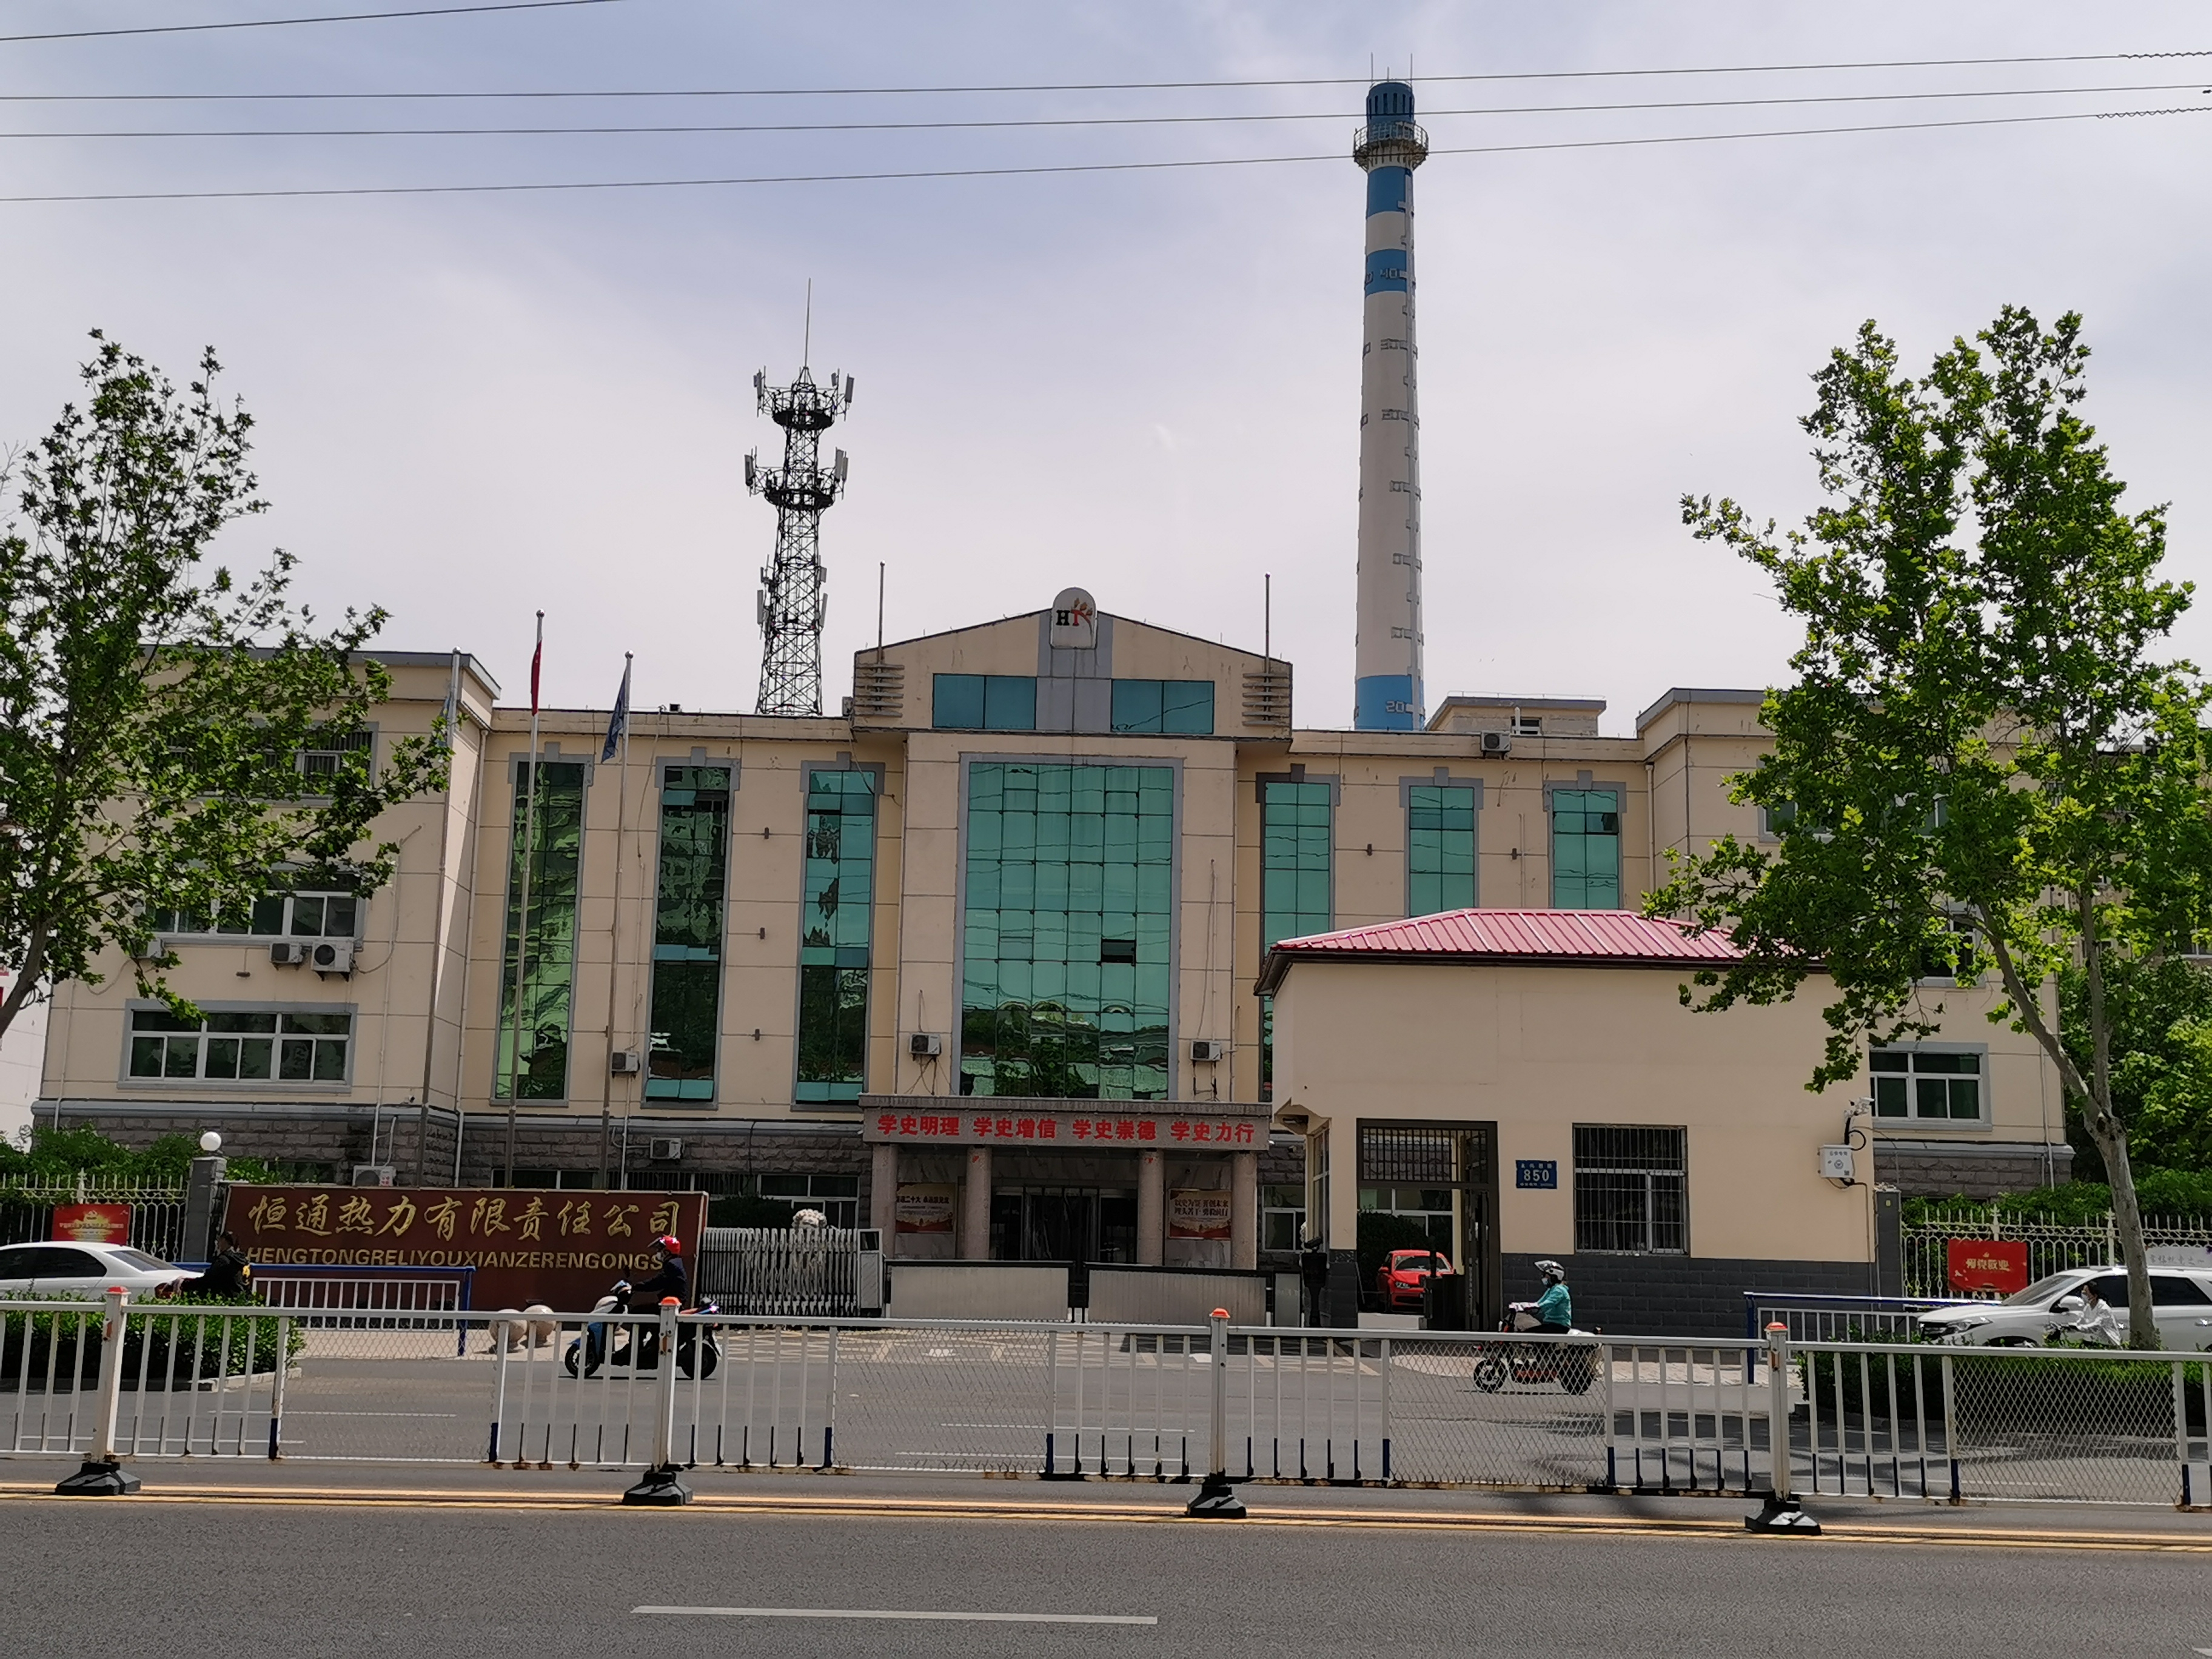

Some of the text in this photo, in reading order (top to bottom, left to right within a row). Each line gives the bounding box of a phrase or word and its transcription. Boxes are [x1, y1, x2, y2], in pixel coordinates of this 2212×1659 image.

[877, 1114, 1255, 1143] 学史明理 学史增信 学史崇德 学史力行
[1524, 1170, 1549, 1181] 850
[248, 1193, 679, 1242] 恒通热力有限责任公司
[246, 1247, 663, 1270] HENGTONGRELIYOUXIANZERENGONGS
